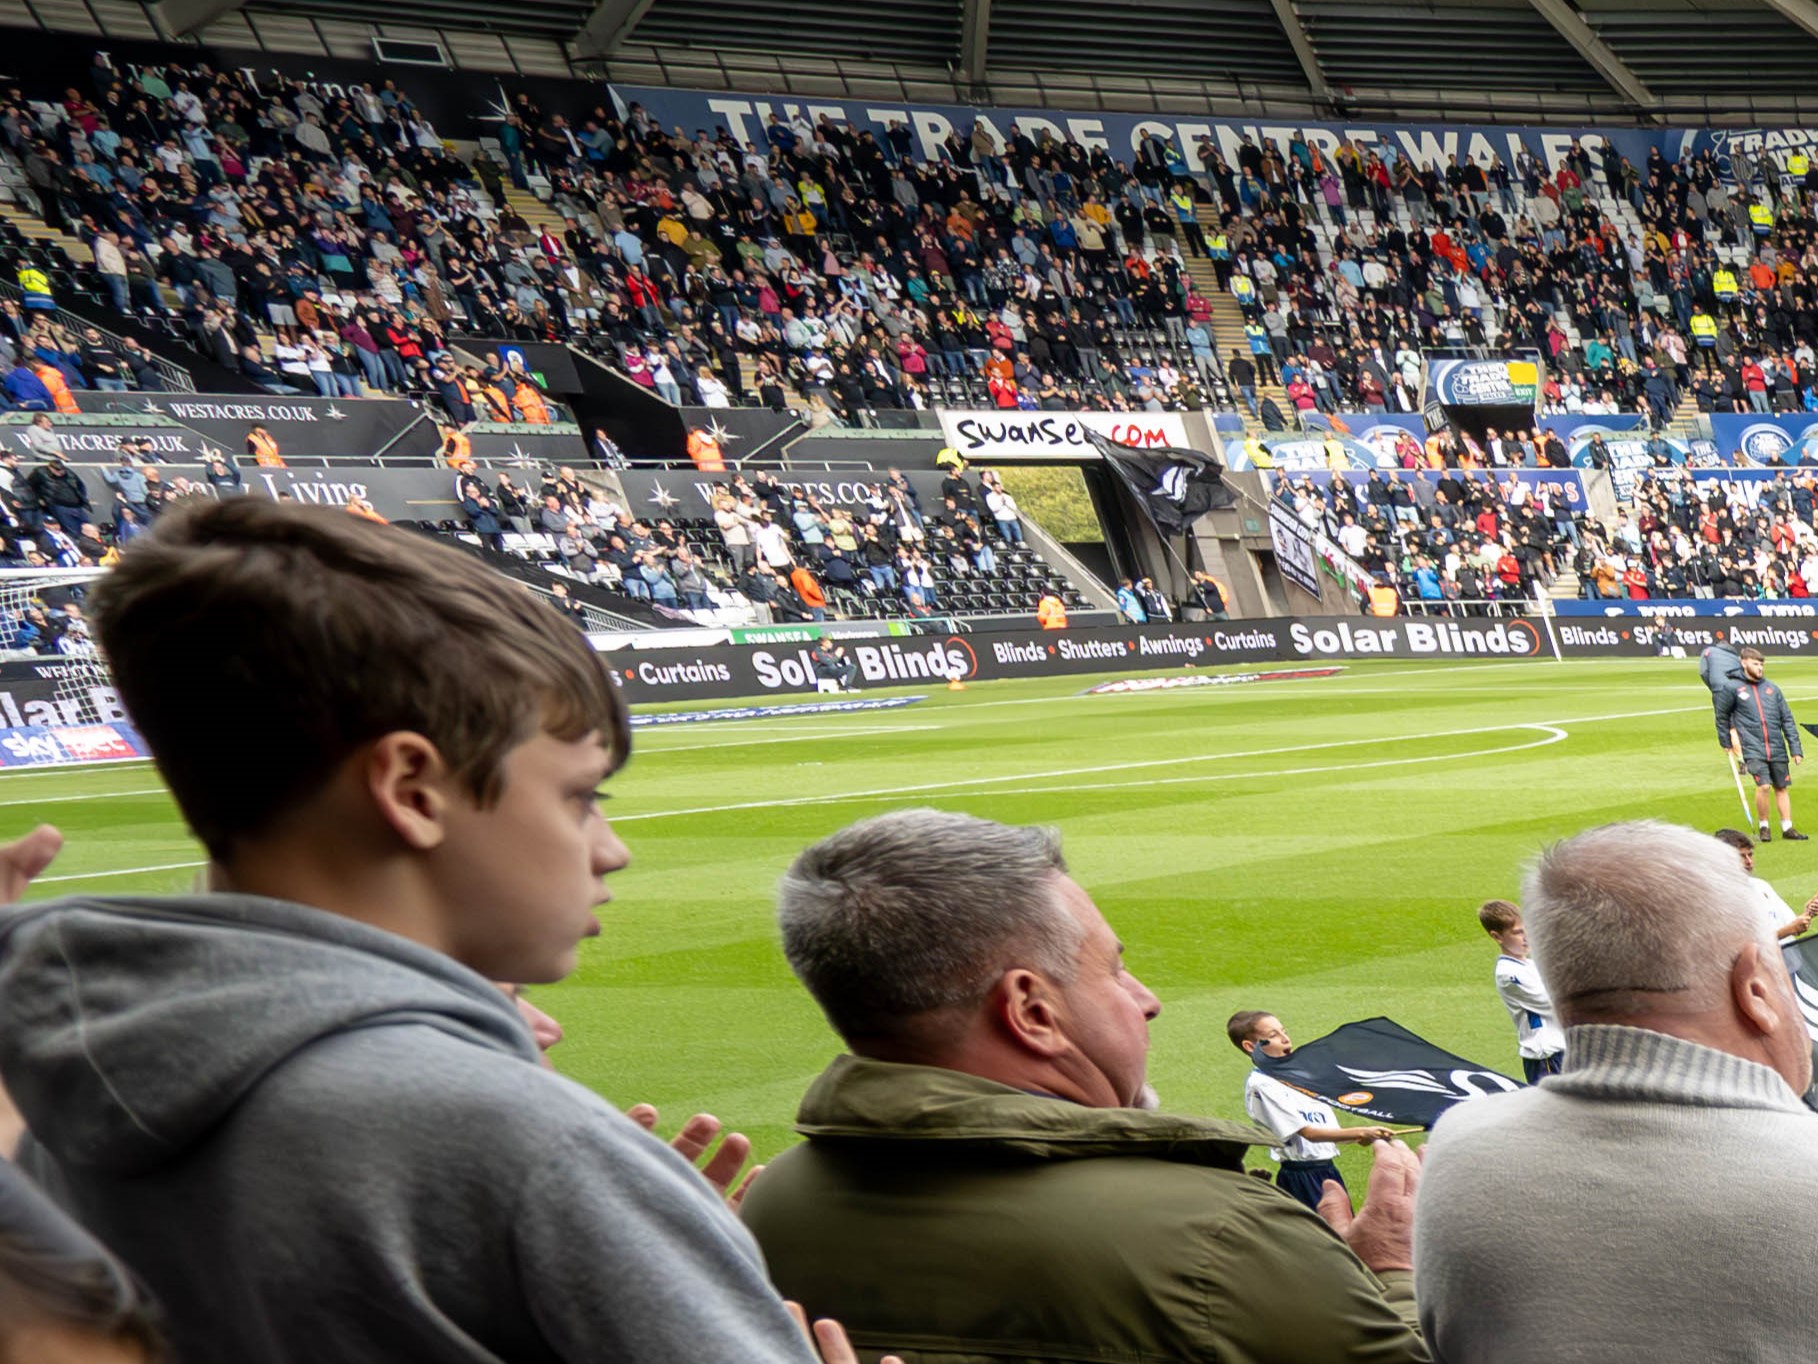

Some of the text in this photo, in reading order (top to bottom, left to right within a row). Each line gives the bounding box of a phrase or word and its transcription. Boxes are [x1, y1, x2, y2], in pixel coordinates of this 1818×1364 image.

[170, 402, 317, 421] WESTACRES.CO.UK
[994, 629, 1277, 665] Blinds Shutters Awnings Curtains
[1290, 622, 1529, 655] Solar Blinds
[1559, 626, 1619, 646] Blinds
[1729, 625, 1809, 650] Awnings
[638, 643, 966, 687] Curtains Blinds
